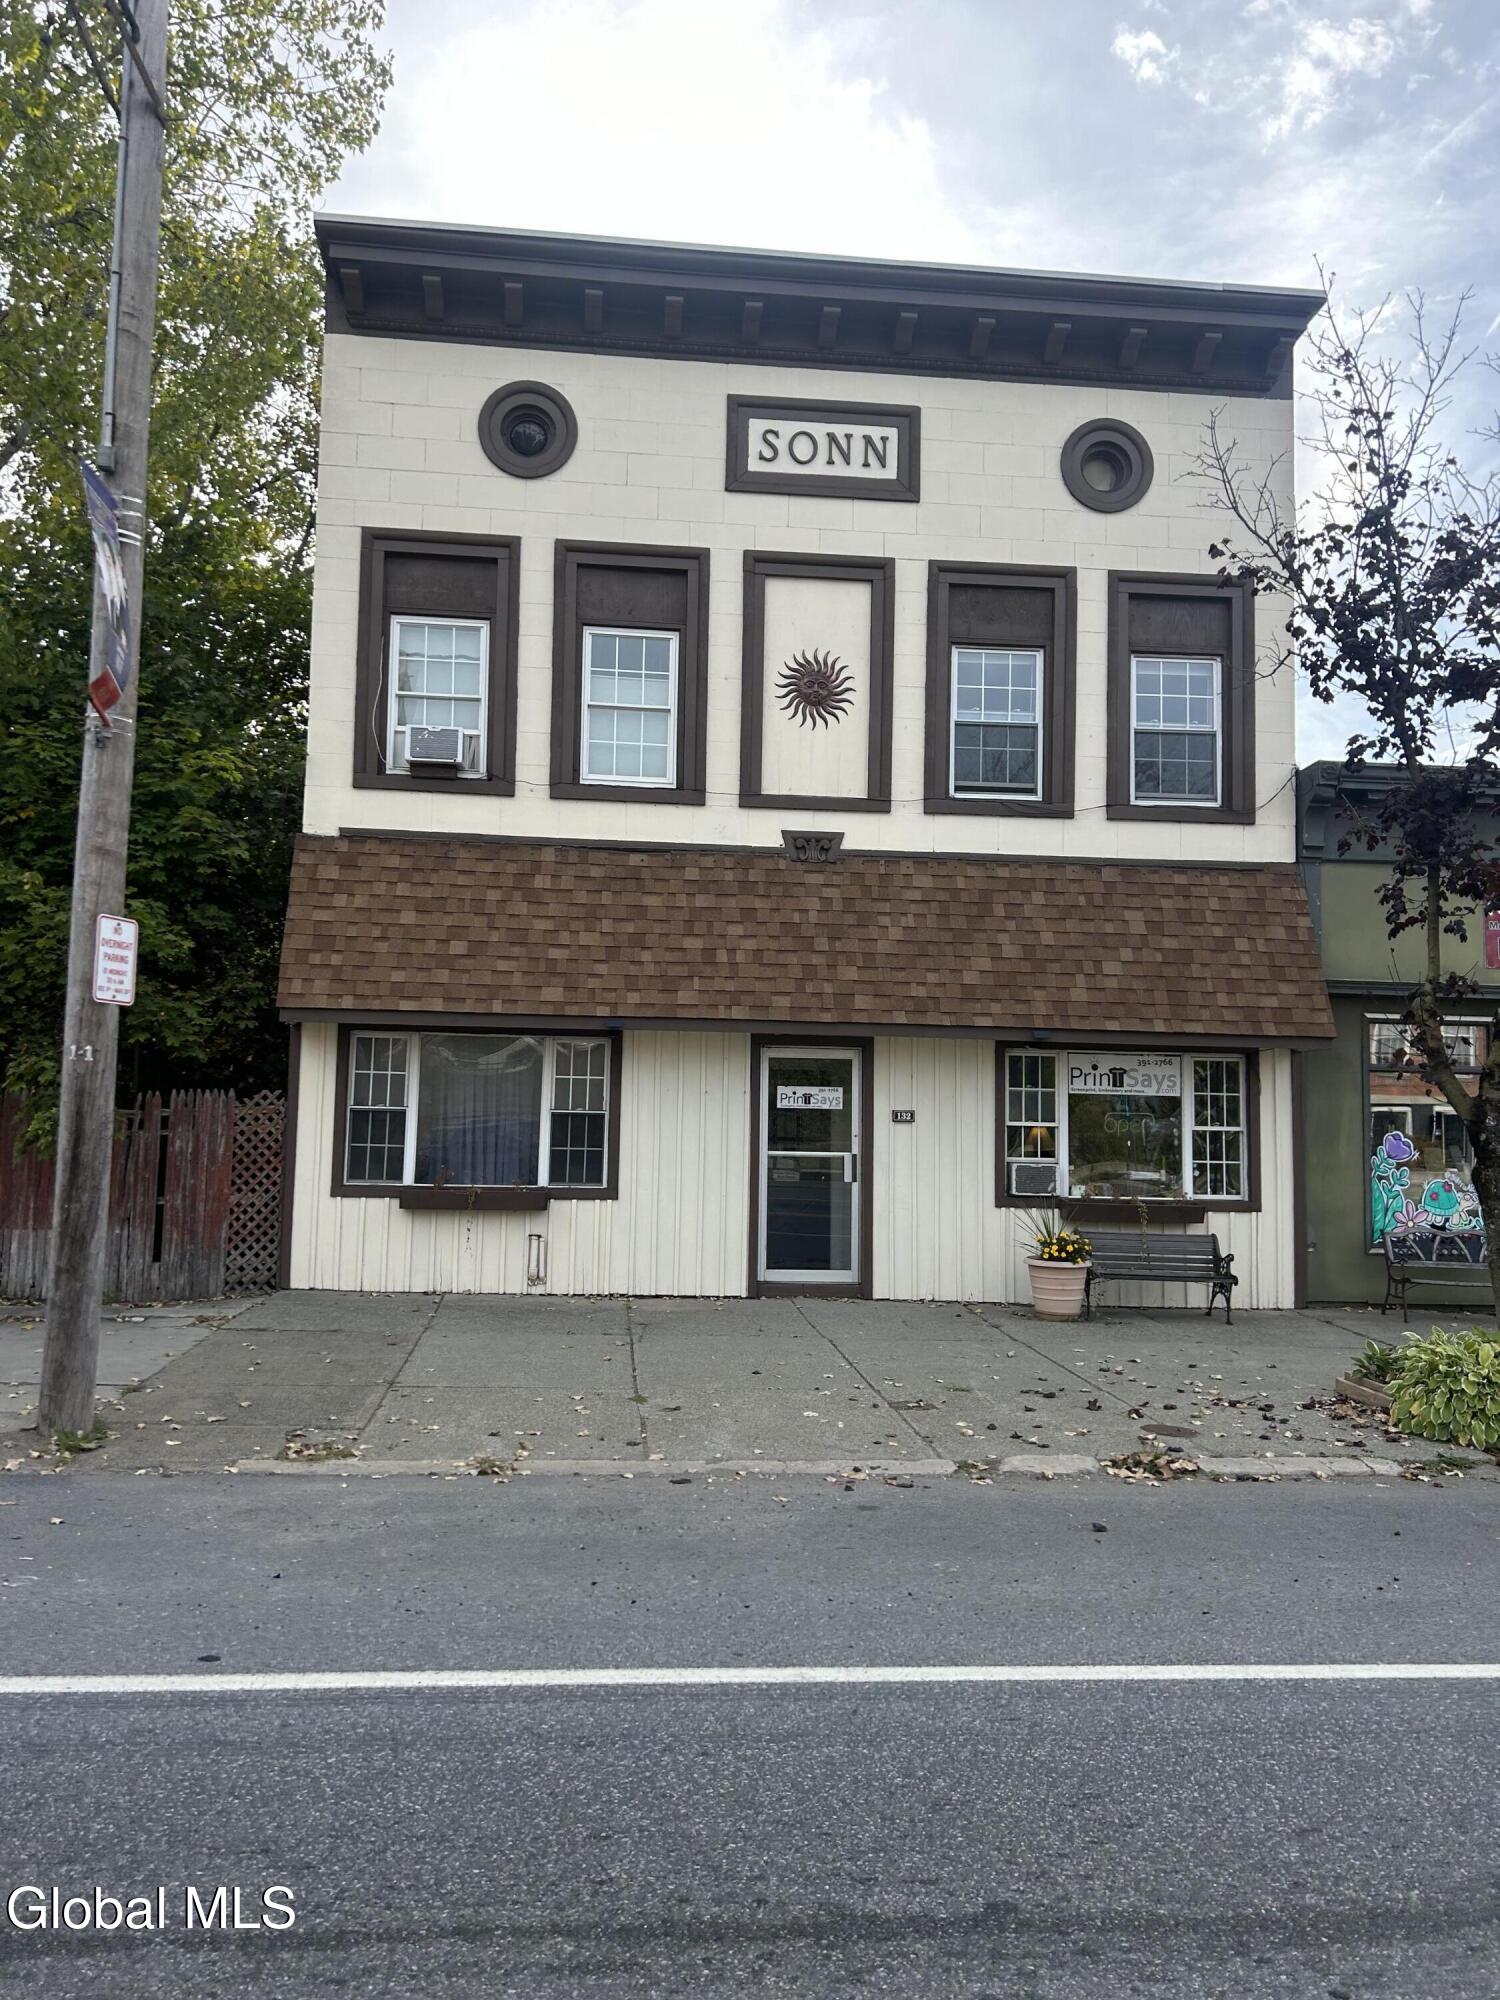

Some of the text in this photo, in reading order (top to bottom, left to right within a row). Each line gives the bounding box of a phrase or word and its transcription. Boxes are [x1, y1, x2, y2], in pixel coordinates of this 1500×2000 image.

[758, 428, 889, 468] SONN
[113, 926, 123, 936] NO
[101, 937, 133, 951] OVERNIGHT
[103, 952, 129, 964] PARKING
[897, 1112, 911, 1120] 132
